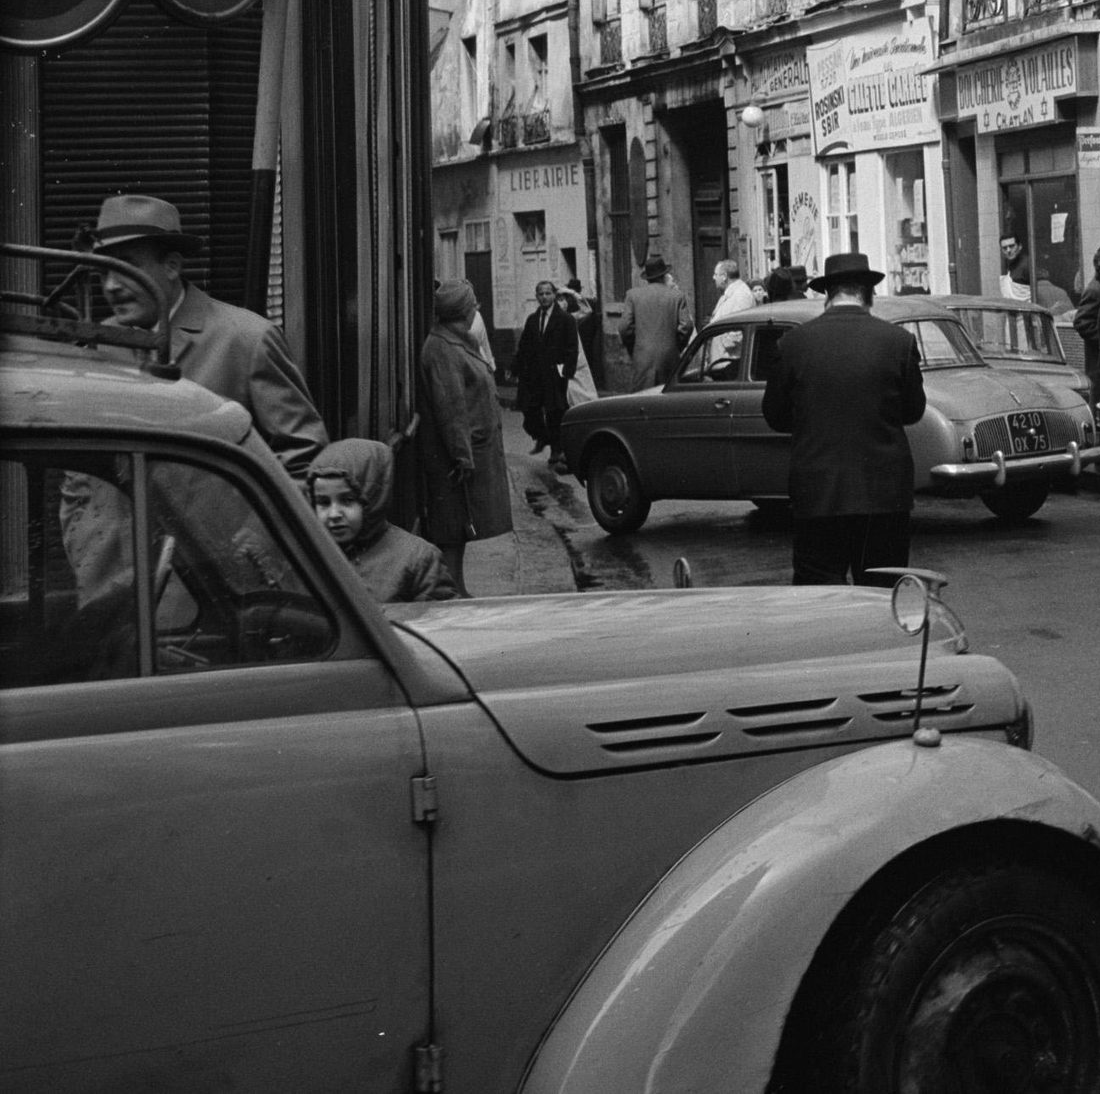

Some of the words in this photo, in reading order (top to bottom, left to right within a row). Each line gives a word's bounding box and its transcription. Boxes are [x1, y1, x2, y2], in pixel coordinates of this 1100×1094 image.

[958, 65, 1005, 111] BOUCHERIE
[1021, 45, 1074, 96] VOLAILLES
[821, 111, 840, 138] SBIR
[510, 164, 579, 192] LIBRAIRIE
[1012, 412, 1041, 429] 4210
[1033, 434, 1047, 450] 75
